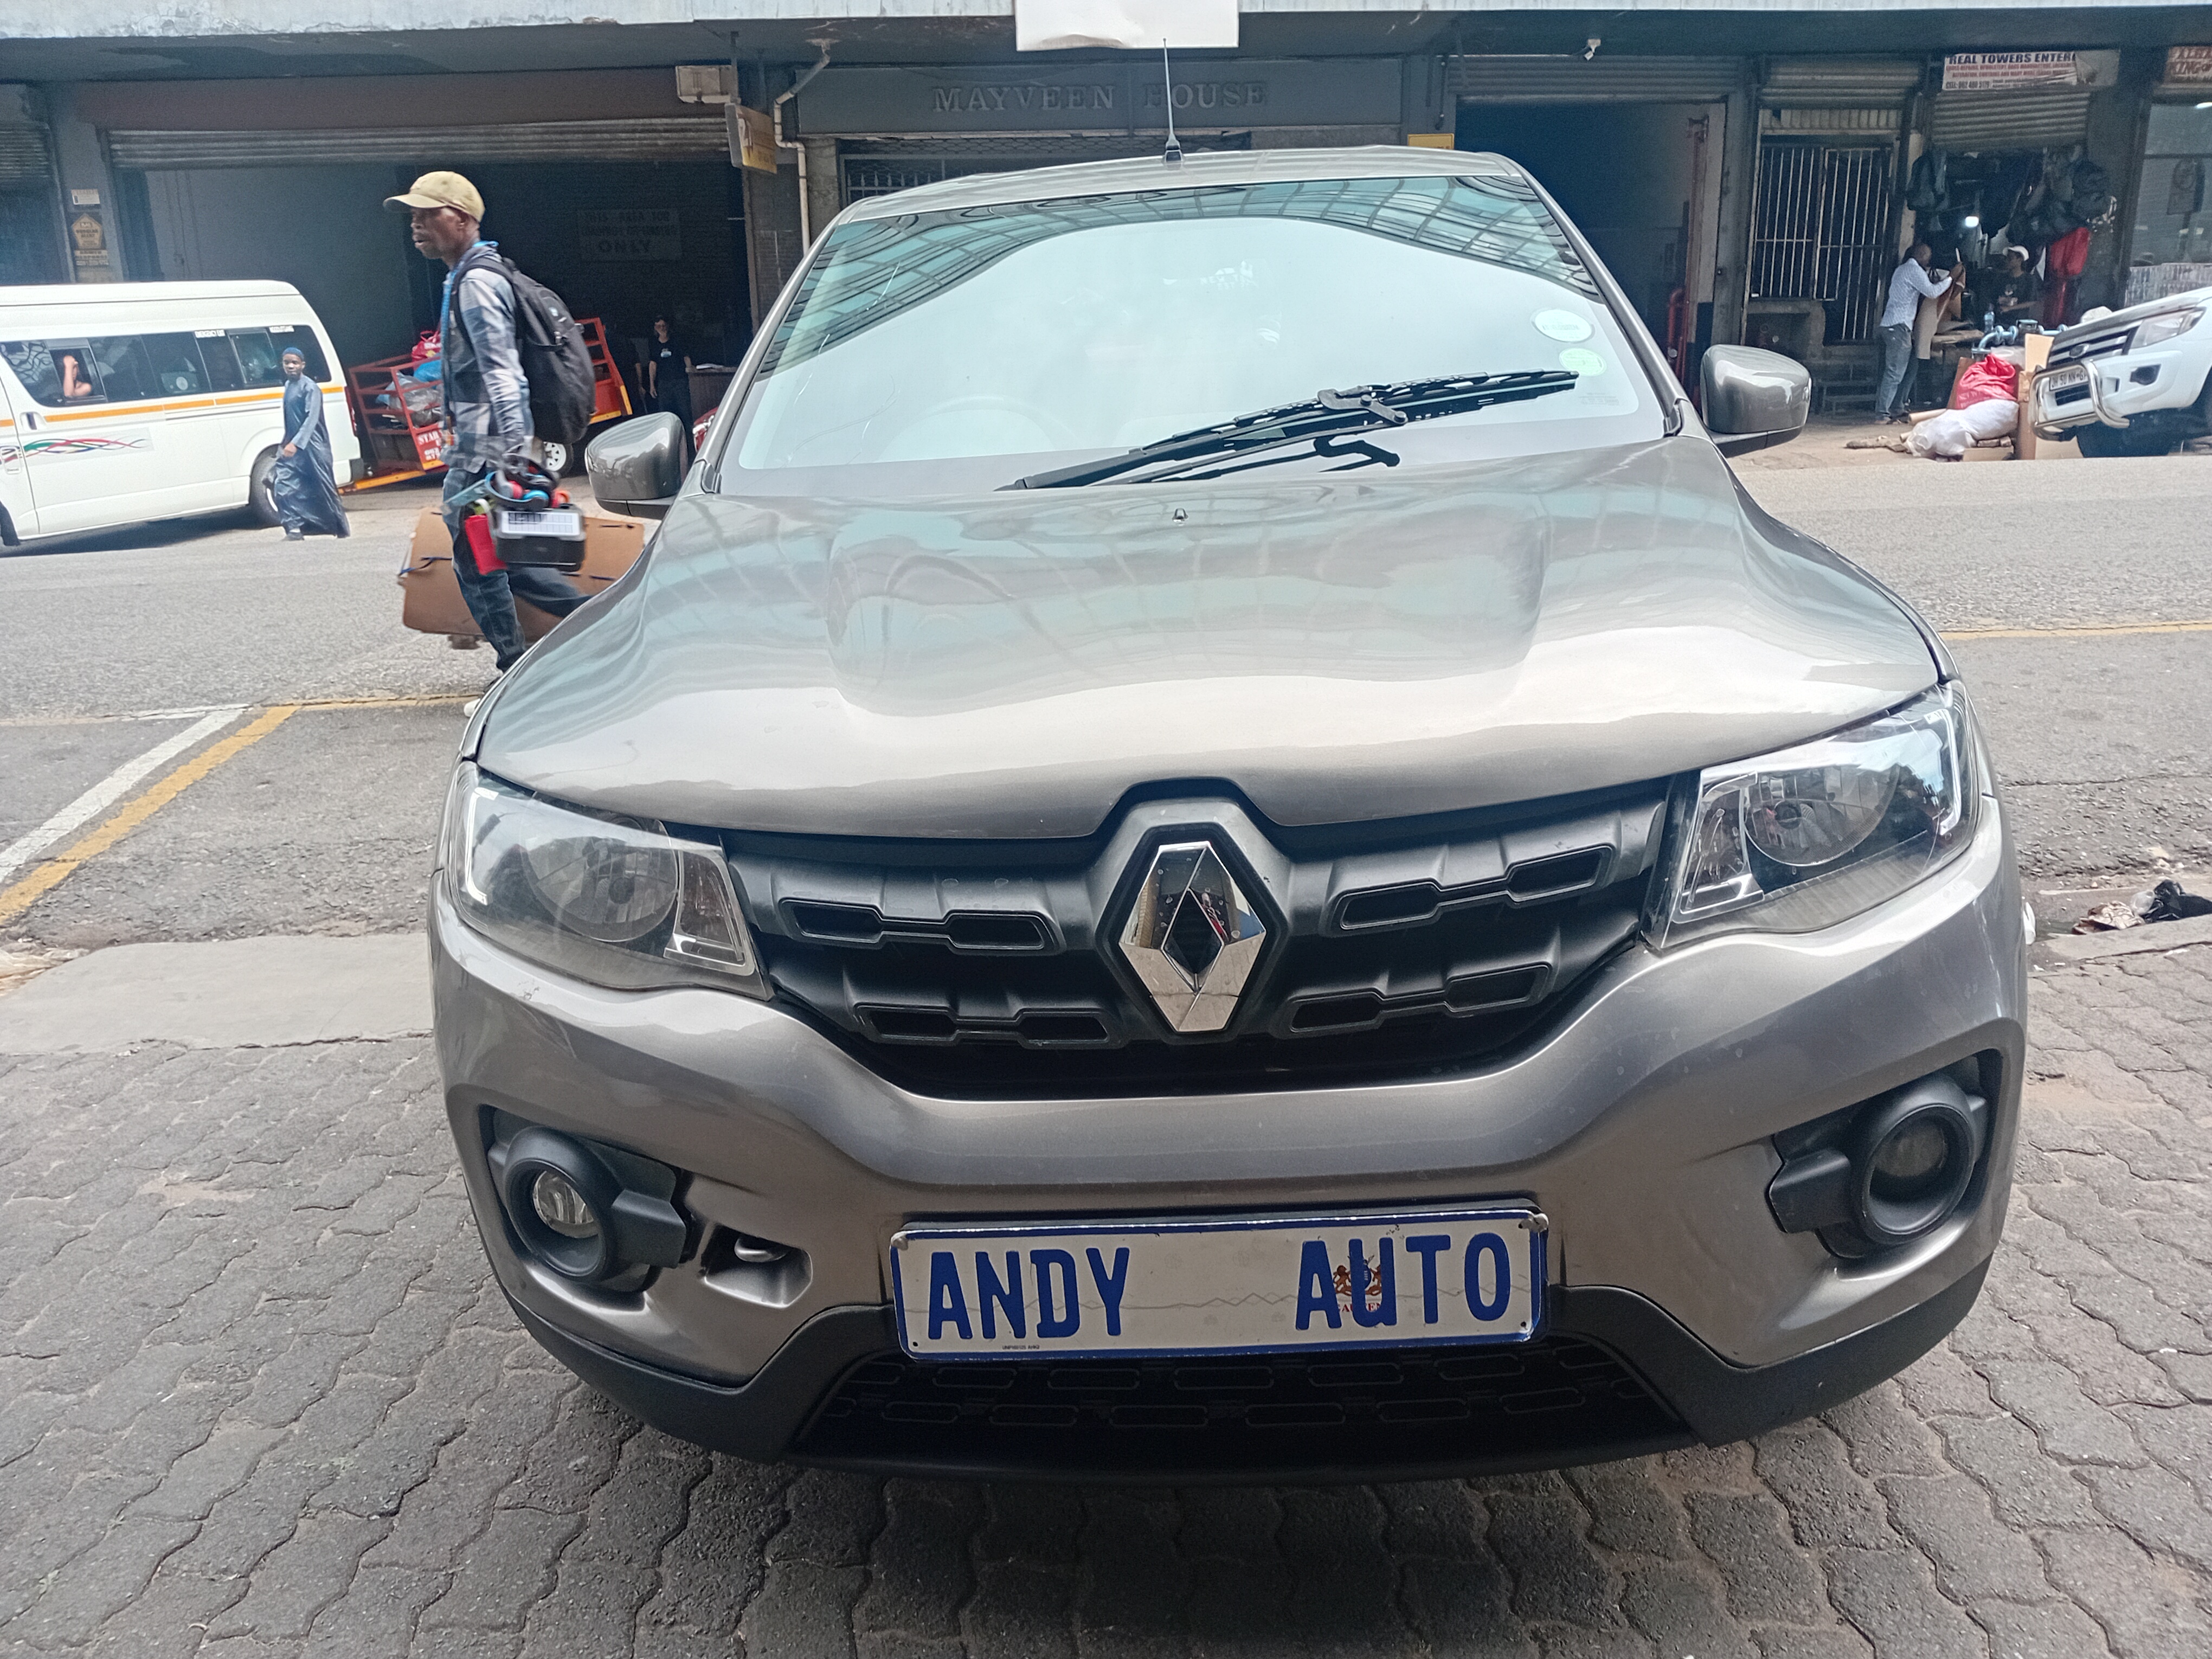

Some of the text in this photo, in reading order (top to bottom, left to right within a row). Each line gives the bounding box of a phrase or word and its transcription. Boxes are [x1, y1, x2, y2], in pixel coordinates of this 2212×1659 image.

[1981, 53, 2032, 64] TOWERS
[932, 81, 1266, 112] MAYVEEN HOUSE
[598, 239, 651, 253] ONLY
[928, 1231, 1510, 1340] ANDY AUTO
